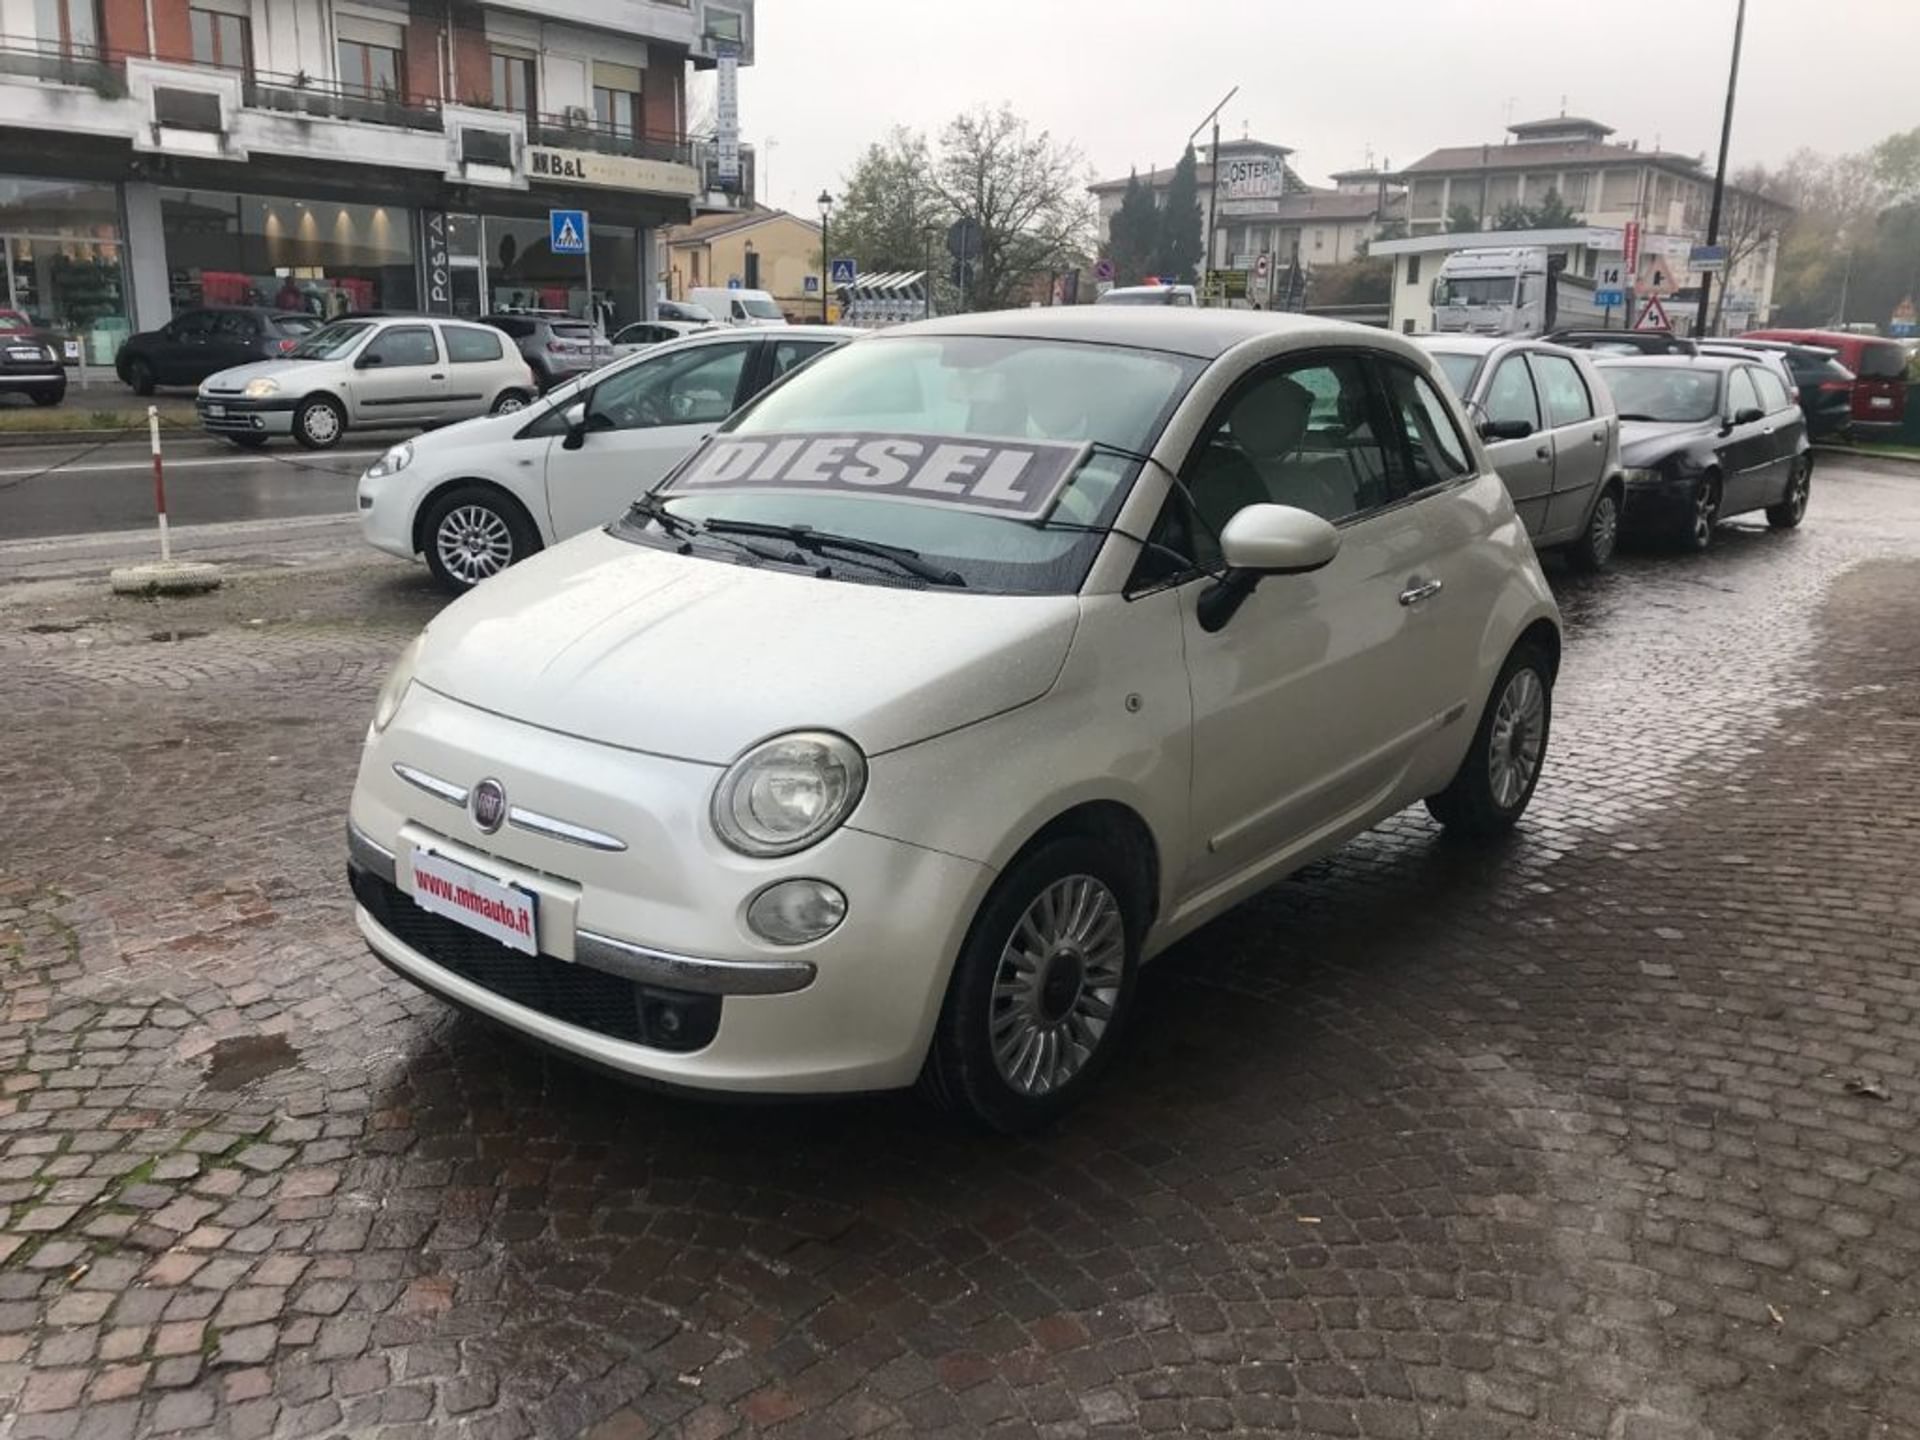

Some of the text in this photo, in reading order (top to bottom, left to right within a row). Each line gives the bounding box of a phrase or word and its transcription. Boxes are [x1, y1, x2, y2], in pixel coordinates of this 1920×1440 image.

[551, 155, 586, 178] B&L
[430, 214, 448, 302] POSTA
[1604, 269, 1619, 284] 14
[687, 438, 1035, 501] DIESEL
[415, 869, 531, 937] www.mmauto.it
